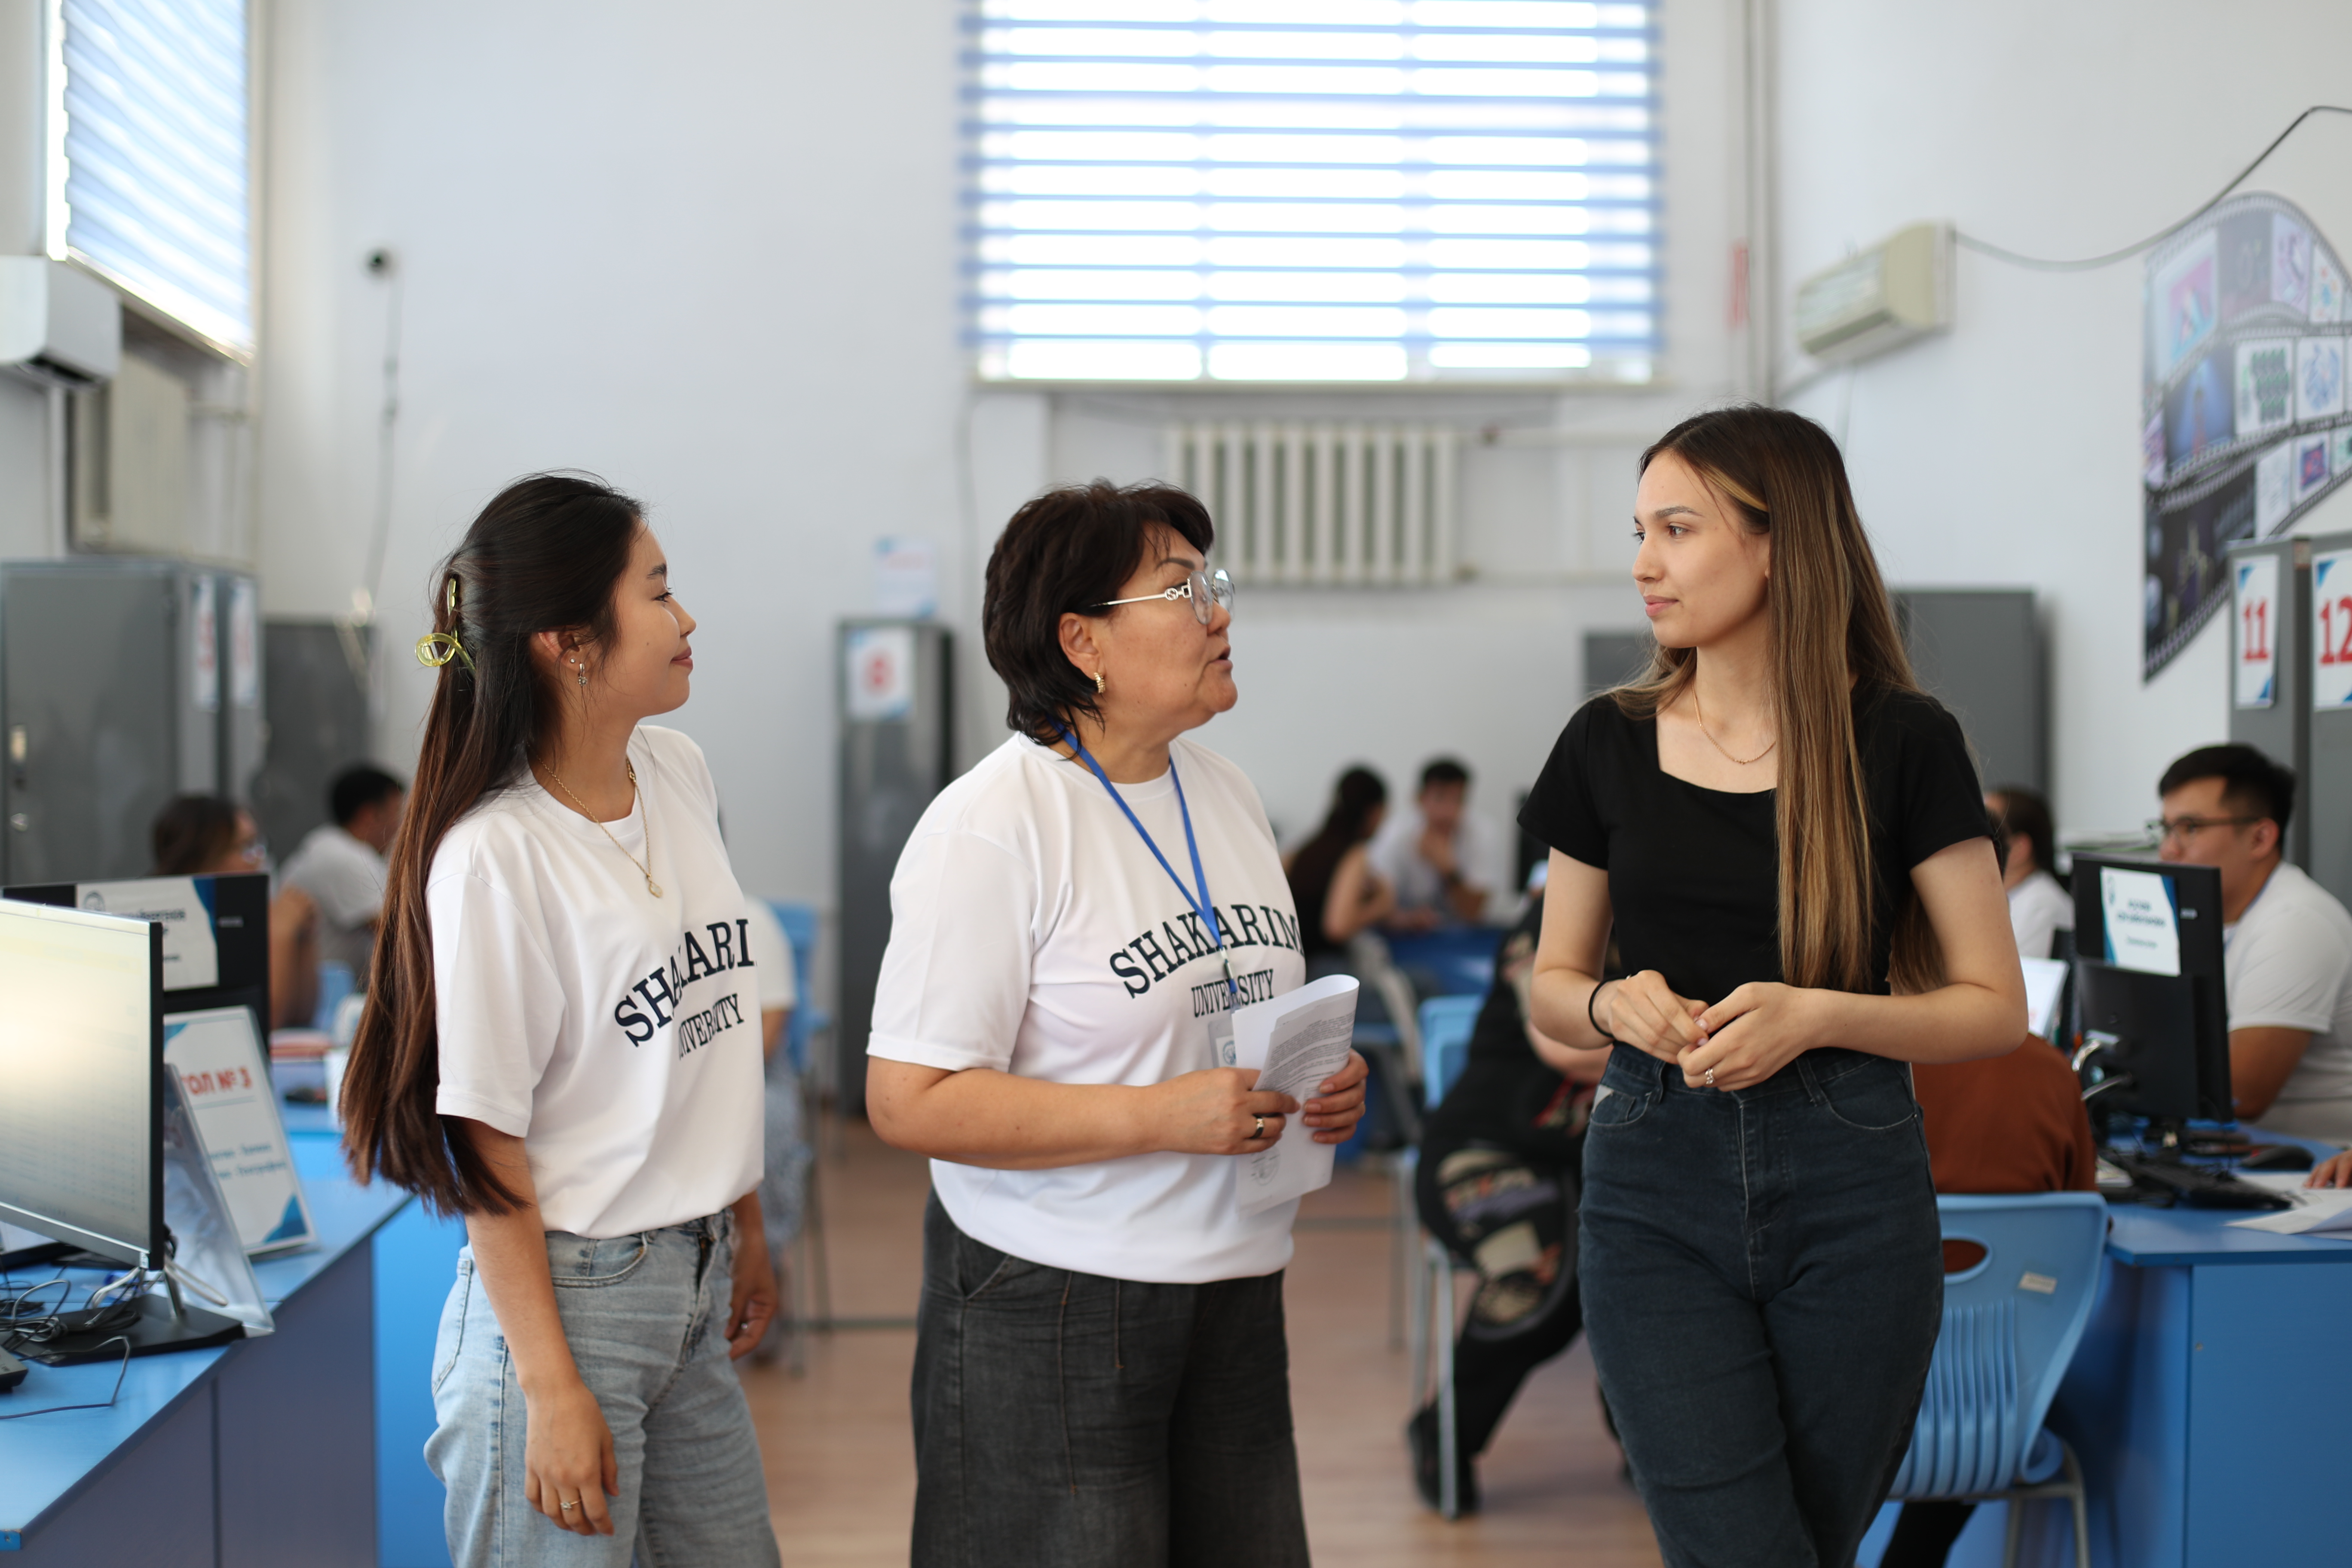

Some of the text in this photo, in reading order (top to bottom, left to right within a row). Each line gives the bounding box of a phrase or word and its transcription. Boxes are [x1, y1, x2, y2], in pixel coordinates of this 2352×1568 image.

[2243, 598, 2269, 661] 11
[2319, 595, 2352, 665] 12
[181, 1072, 215, 1095] ОЛ
